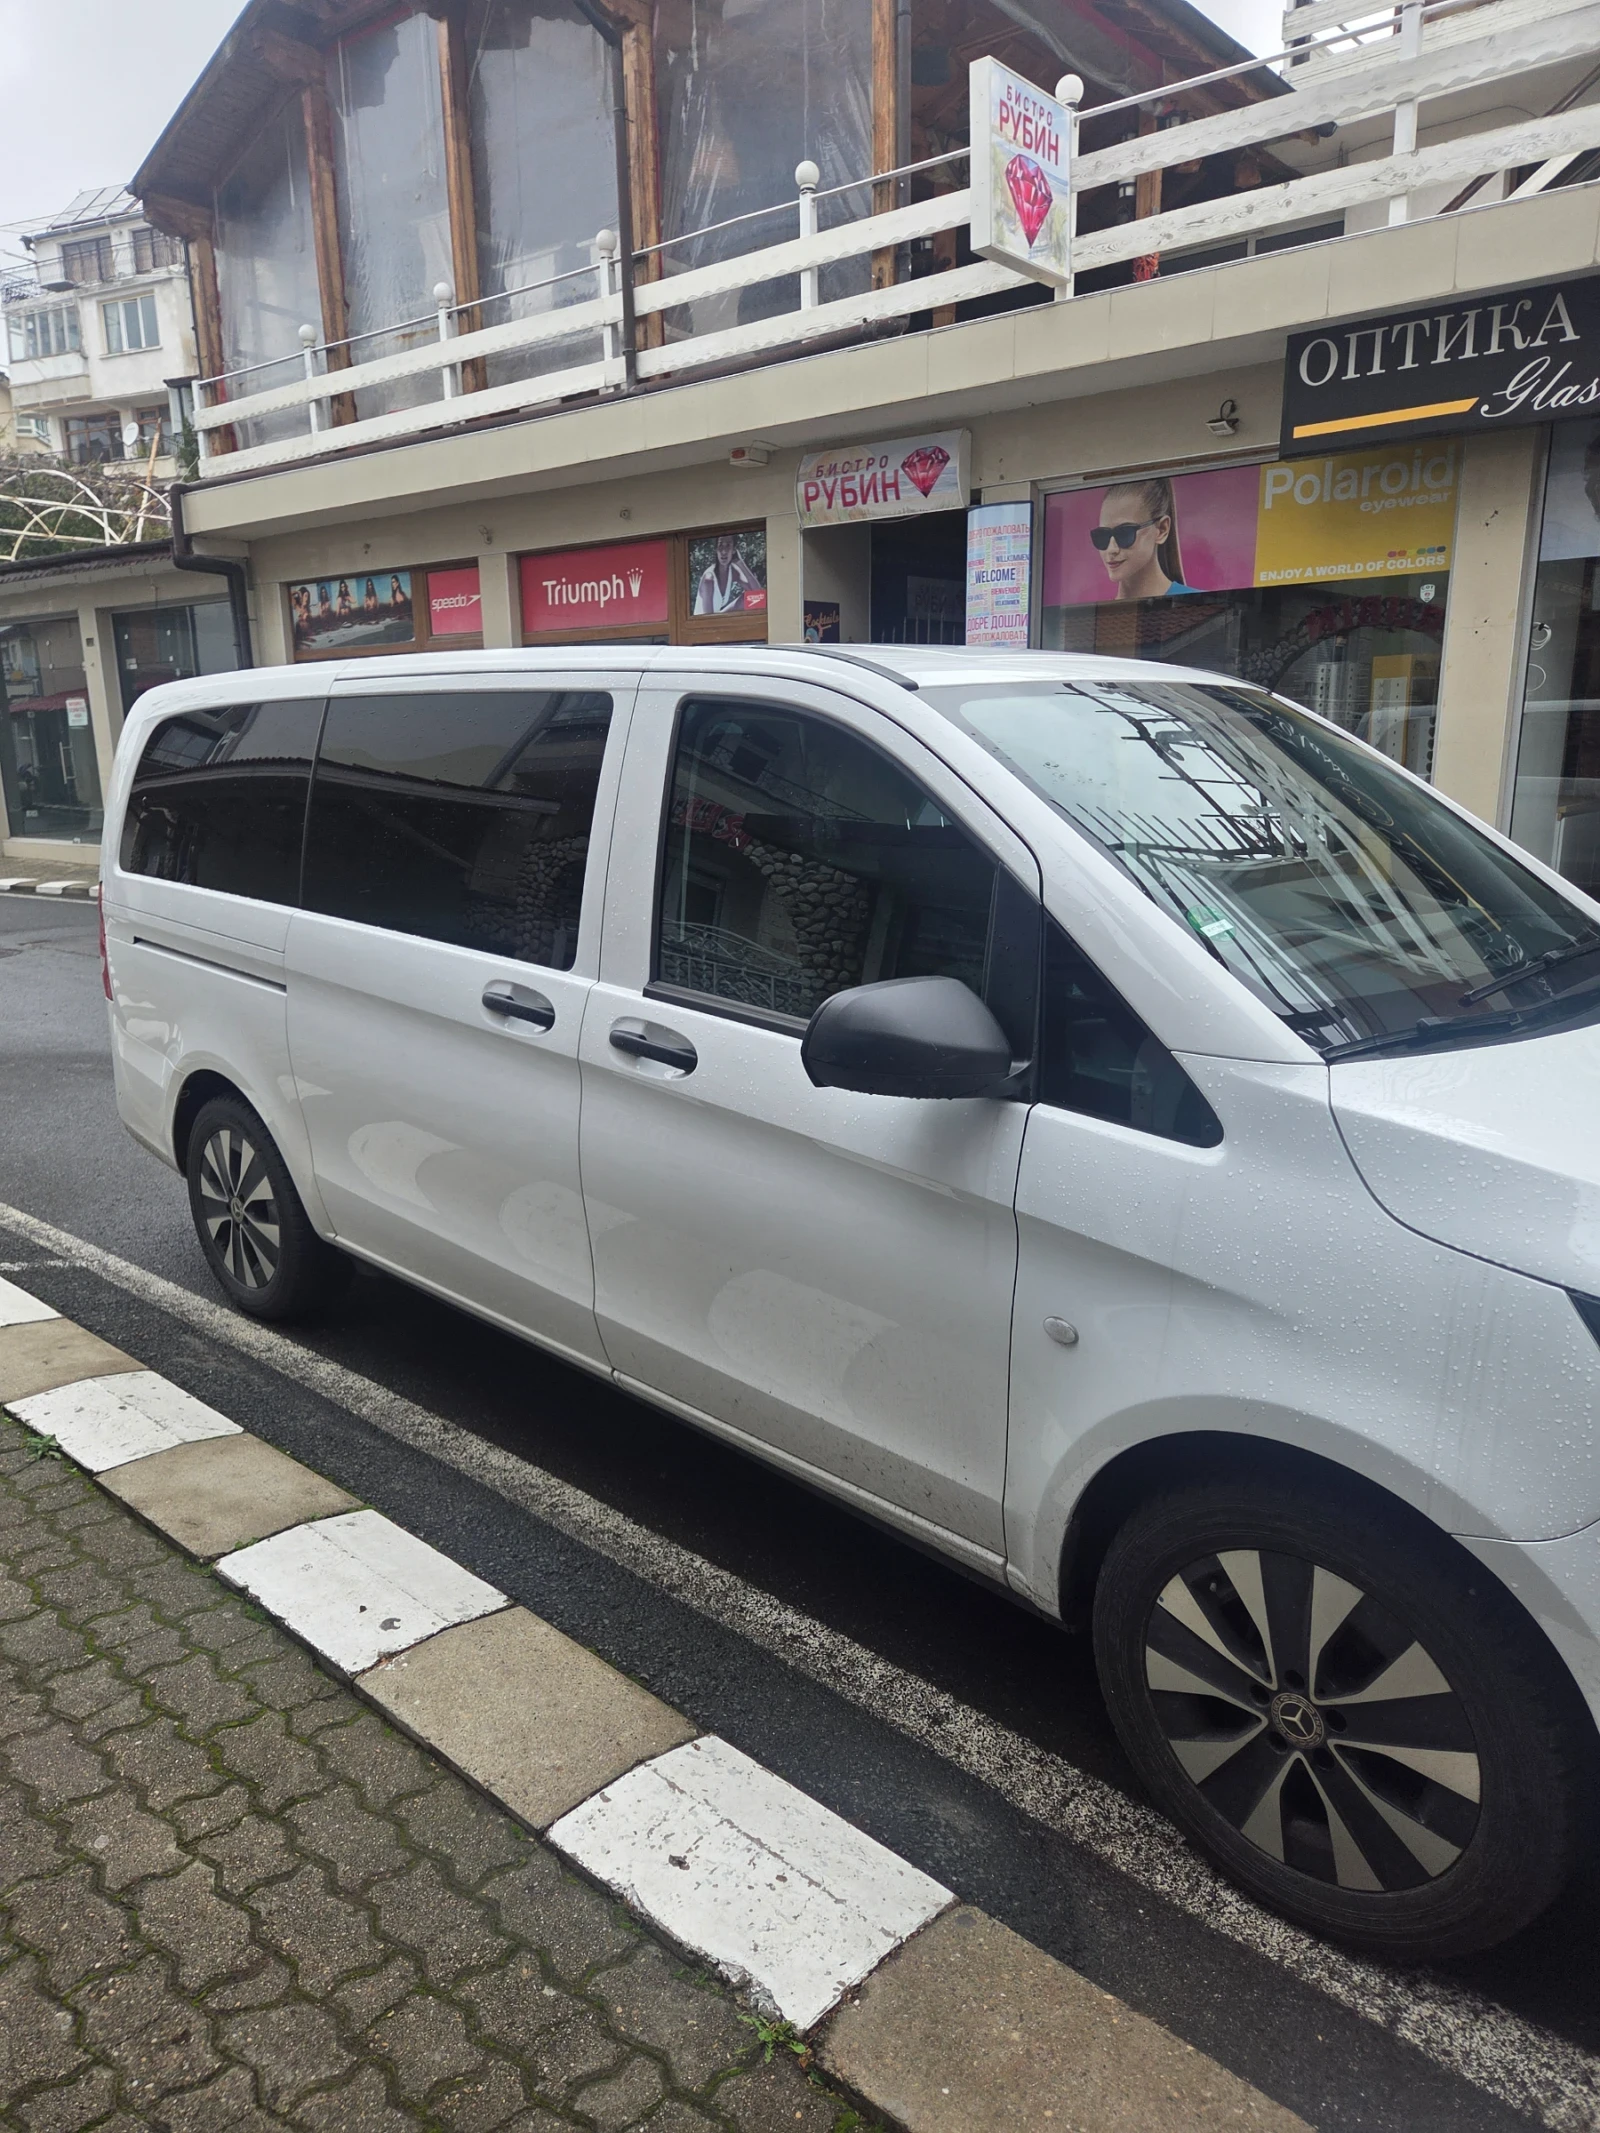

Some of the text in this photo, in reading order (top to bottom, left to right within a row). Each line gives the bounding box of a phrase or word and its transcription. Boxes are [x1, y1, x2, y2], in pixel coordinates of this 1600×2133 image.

[1006, 84, 1053, 127] БИСТРО
[999, 98, 1059, 167] РУБИН
[1300, 292, 1580, 386] ОПТИКА
[815, 455, 889, 478] БИСТРО
[1264, 444, 1455, 509] Polaroid
[804, 469, 901, 512] РУБИН
[1359, 491, 1451, 514] eyewear
[983, 523, 1030, 537] ПОЖАЛОВАТЬ
[975, 567, 1016, 584] WELCOME
[1259, 554, 1446, 581] ENJOY A WORLD OF COLORS
[431, 593, 467, 612] speedo
[542, 573, 625, 609] Triumph
[967, 613, 1028, 632] ДОБРЕ ДОШЛИ
[982, 630, 1028, 642] ПОЖАЛОВАТЬ
